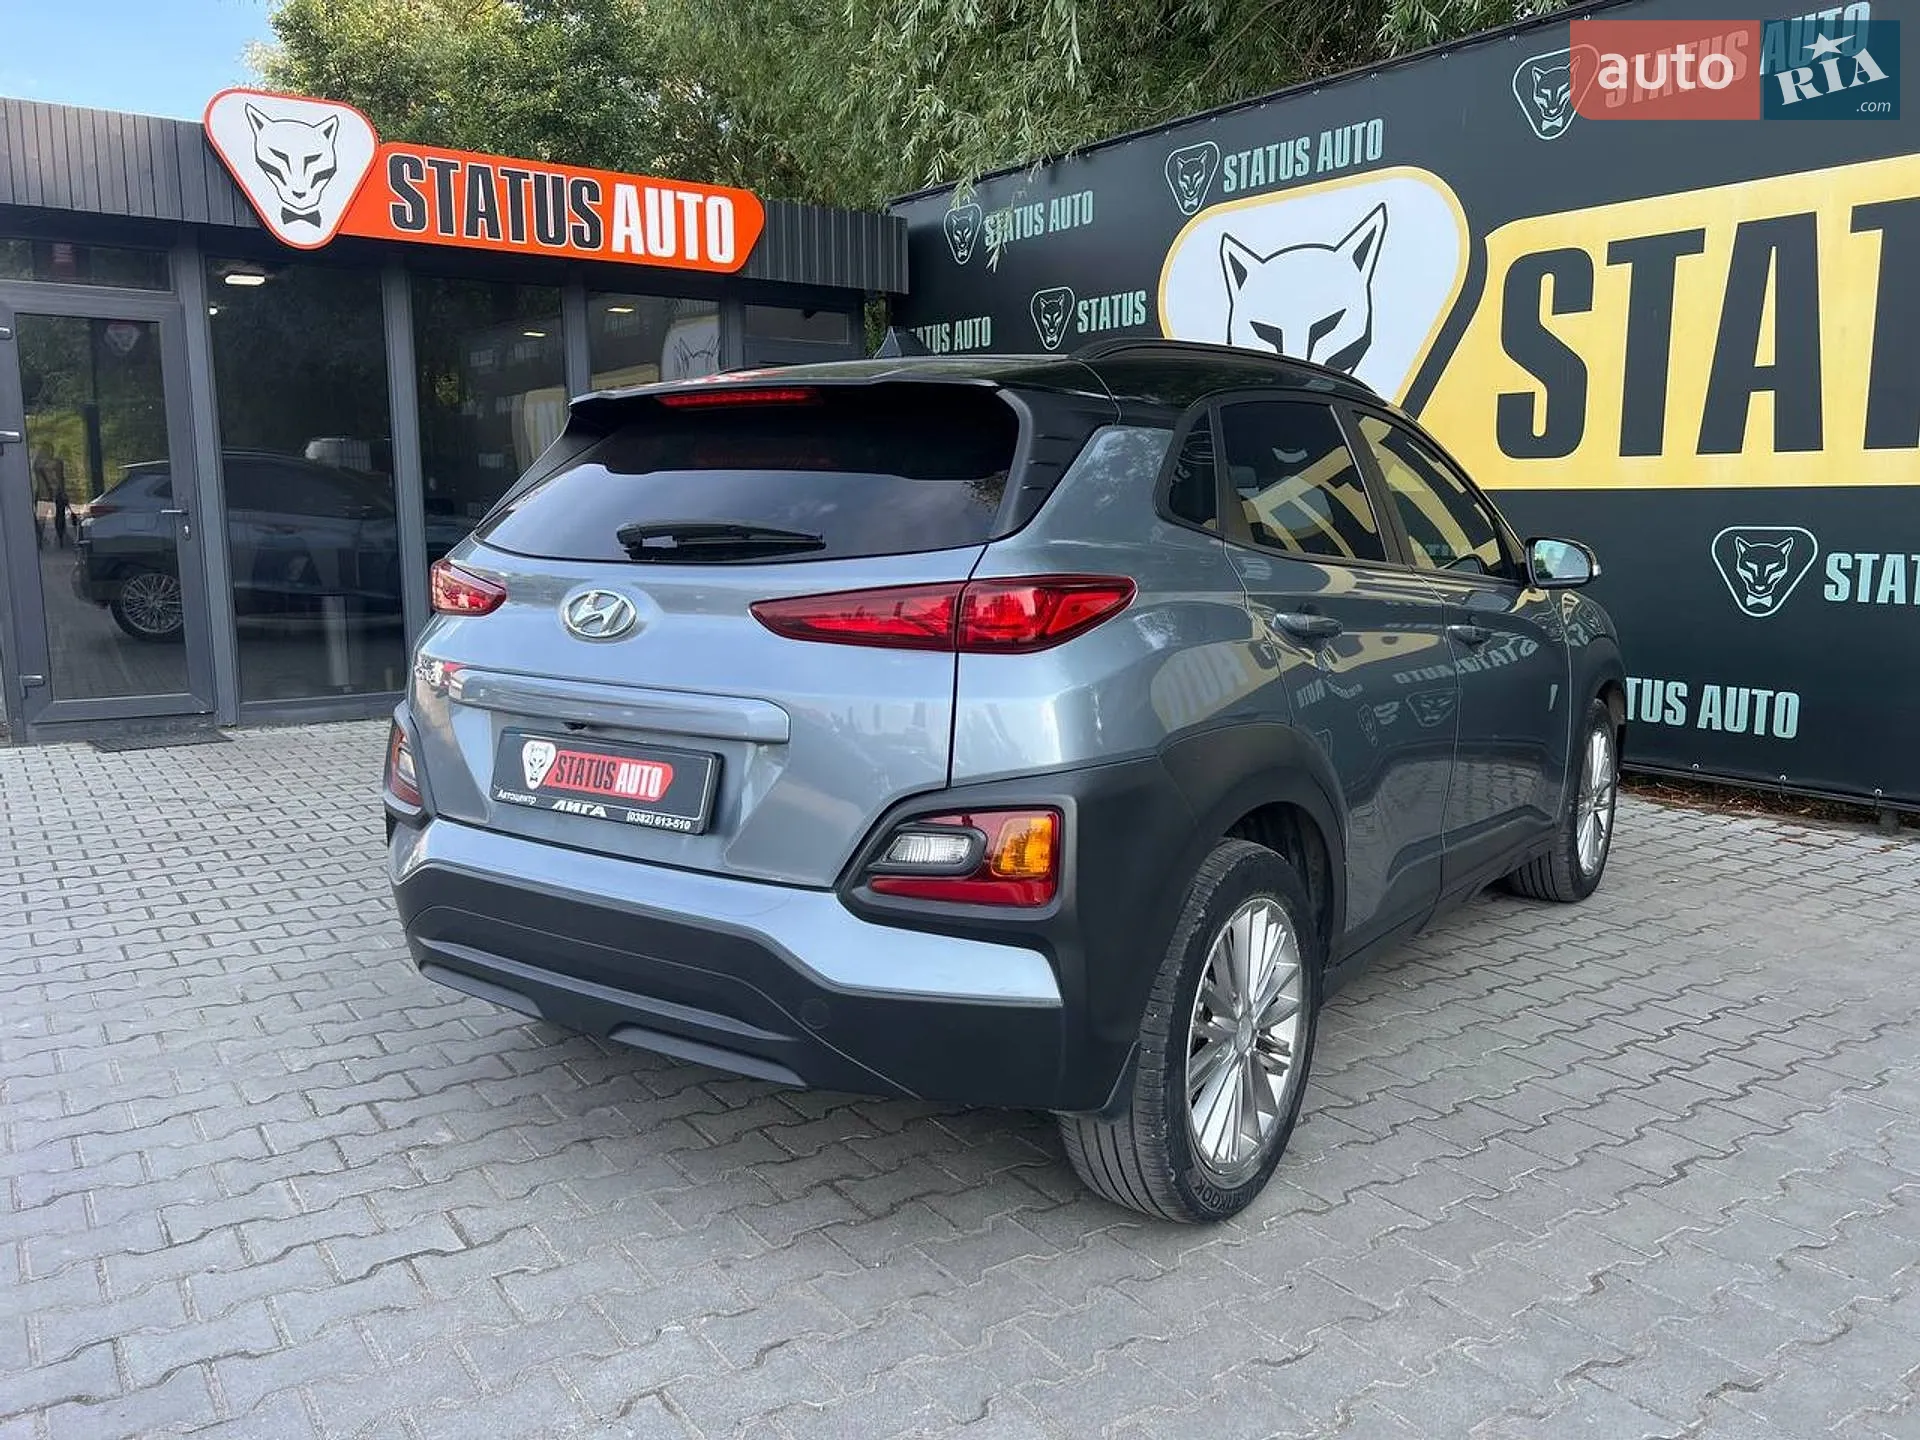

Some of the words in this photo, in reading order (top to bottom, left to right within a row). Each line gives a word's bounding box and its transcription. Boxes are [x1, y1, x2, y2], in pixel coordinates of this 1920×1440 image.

[1223, 135, 1311, 193] STATUS
[1316, 118, 1384, 171] AUTO
[387, 153, 603, 252] STATUS
[612, 183, 735, 264] AUTO
[983, 201, 1045, 247] STATUS
[1049, 190, 1094, 233] AUTO
[954, 316, 992, 351] AUTO
[1077, 290, 1147, 333] STATUS
[1496, 197, 1920, 459] STAT
[1697, 684, 1800, 740] AUTO
[555, 755, 616, 790] STATUS
[615, 762, 663, 798] AUTO
[552, 800, 607, 818] ЛИГА
